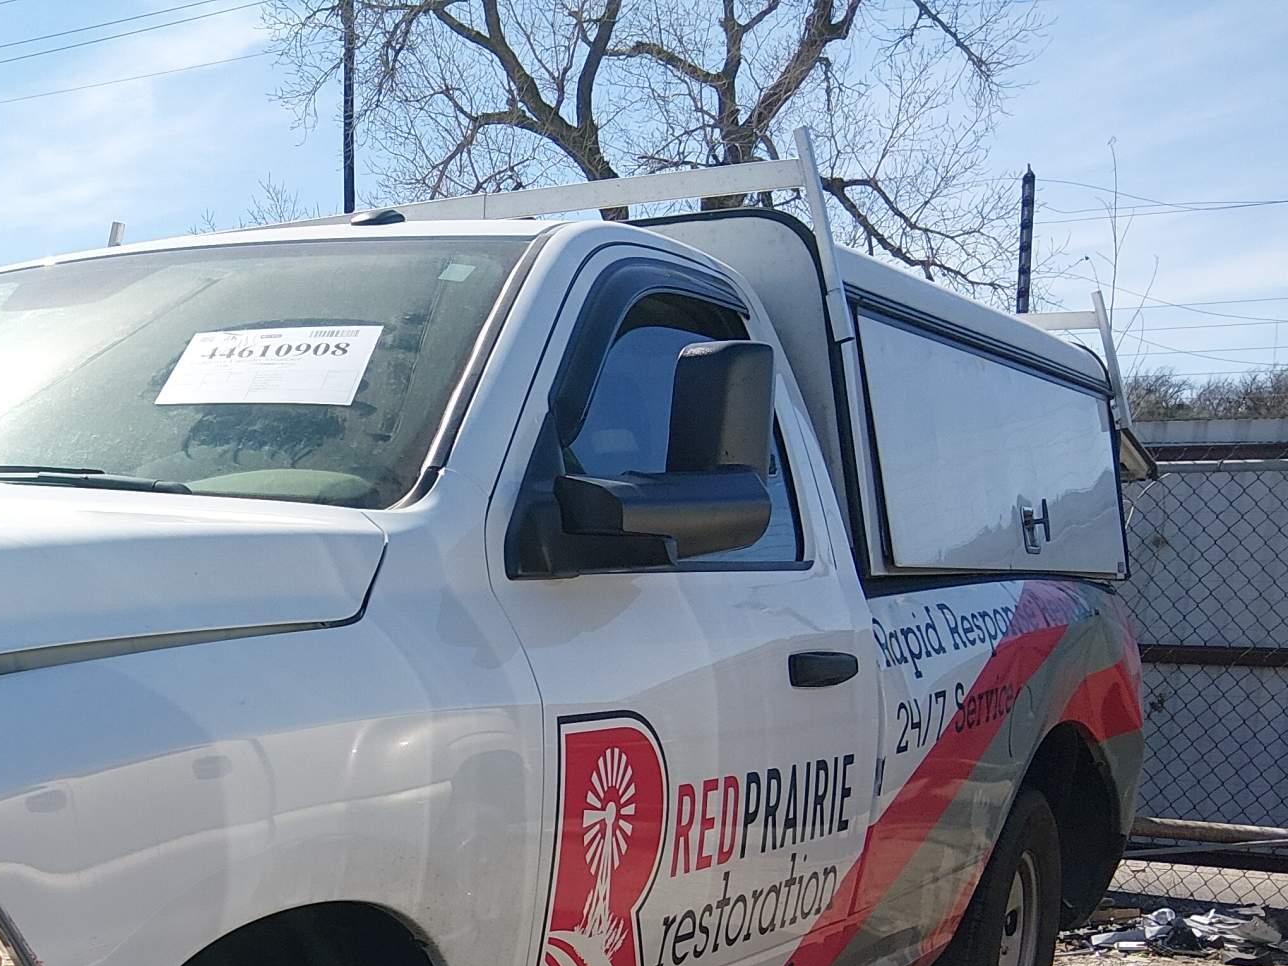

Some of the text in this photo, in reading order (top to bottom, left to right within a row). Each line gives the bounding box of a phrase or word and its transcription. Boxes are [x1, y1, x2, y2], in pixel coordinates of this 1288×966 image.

[200, 341, 351, 361] 44610908
[872, 605, 946, 679] Rapid
[896, 690, 947, 754] 24/7
[670, 753, 856, 878] REDPRAIRIE
